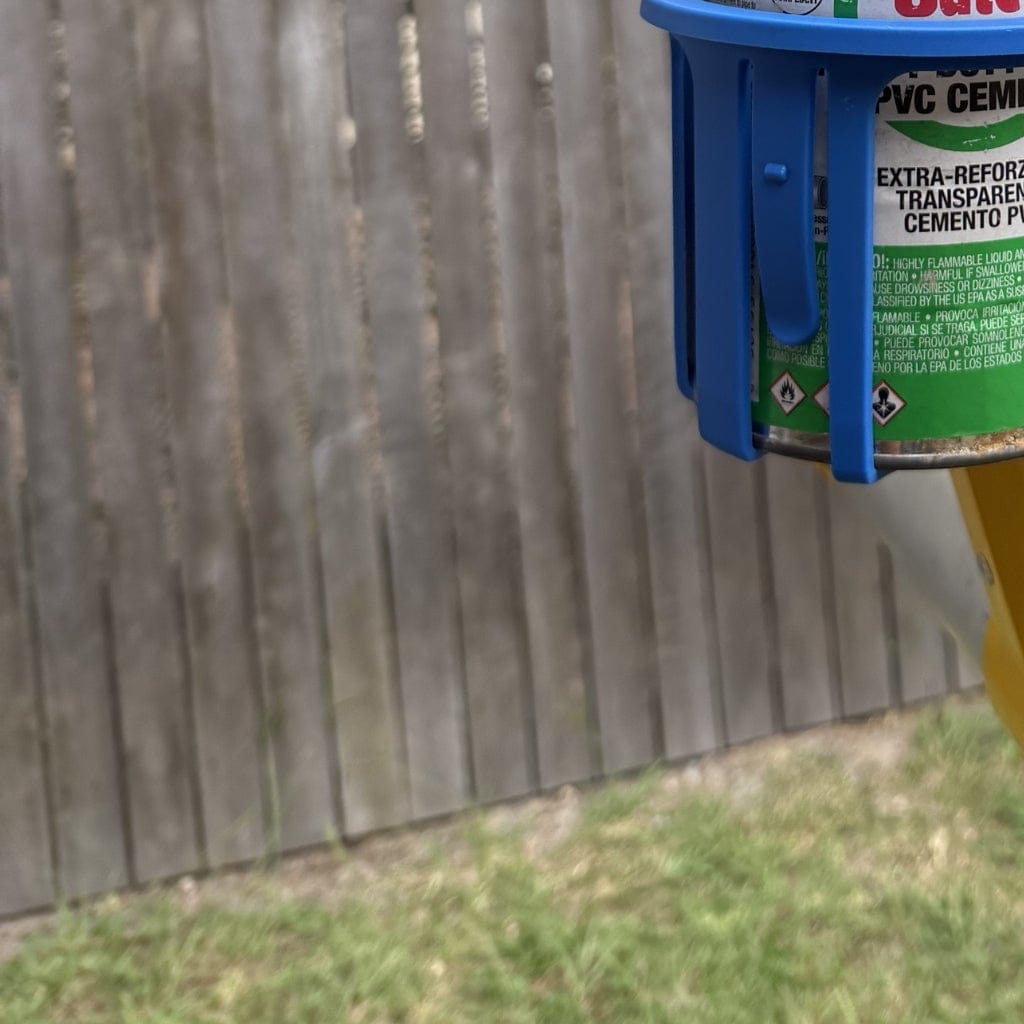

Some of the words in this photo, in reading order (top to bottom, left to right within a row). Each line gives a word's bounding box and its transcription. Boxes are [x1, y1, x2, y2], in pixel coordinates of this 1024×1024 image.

[875, 83, 936, 114] PVC
[904, 208, 1001, 233] CEMENTO
[893, 257, 924, 269] HIGHLY
[928, 254, 983, 269] FLAMMABLE
[986, 250, 1013, 264] LIQUID
[920, 267, 963, 281] HARMFUL
[966, 266, 974, 280] IF
[894, 281, 955, 294] DROWSINESS
[957, 279, 970, 292] OR
[972, 274, 1015, 291] DIZZINESS
[919, 295, 931, 307] BY
[933, 294, 951, 306] THE
[953, 292, 965, 305] US
[967, 290, 984, 304] EPA
[985, 288, 997, 301] AS
[998, 287, 1005, 299] A
[935, 308, 978, 322] PROVOCA
[920, 324, 929, 335] SI
[931, 323, 943, 335] SE
[980, 316, 1009, 331] PUEDE
[883, 348, 949, 361] RESPIRATORIO
[963, 340, 1006, 357] CONTIENE
[884, 336, 914, 349] PUEDE
[918, 334, 968, 348] PROVOCAR
[893, 361, 913, 373] POR
[915, 361, 928, 373] LA
[930, 360, 947, 372] EPA
[949, 359, 962, 371] DE
[964, 357, 982, 369] LOS
[983, 350, 1022, 367] ESTADOS
